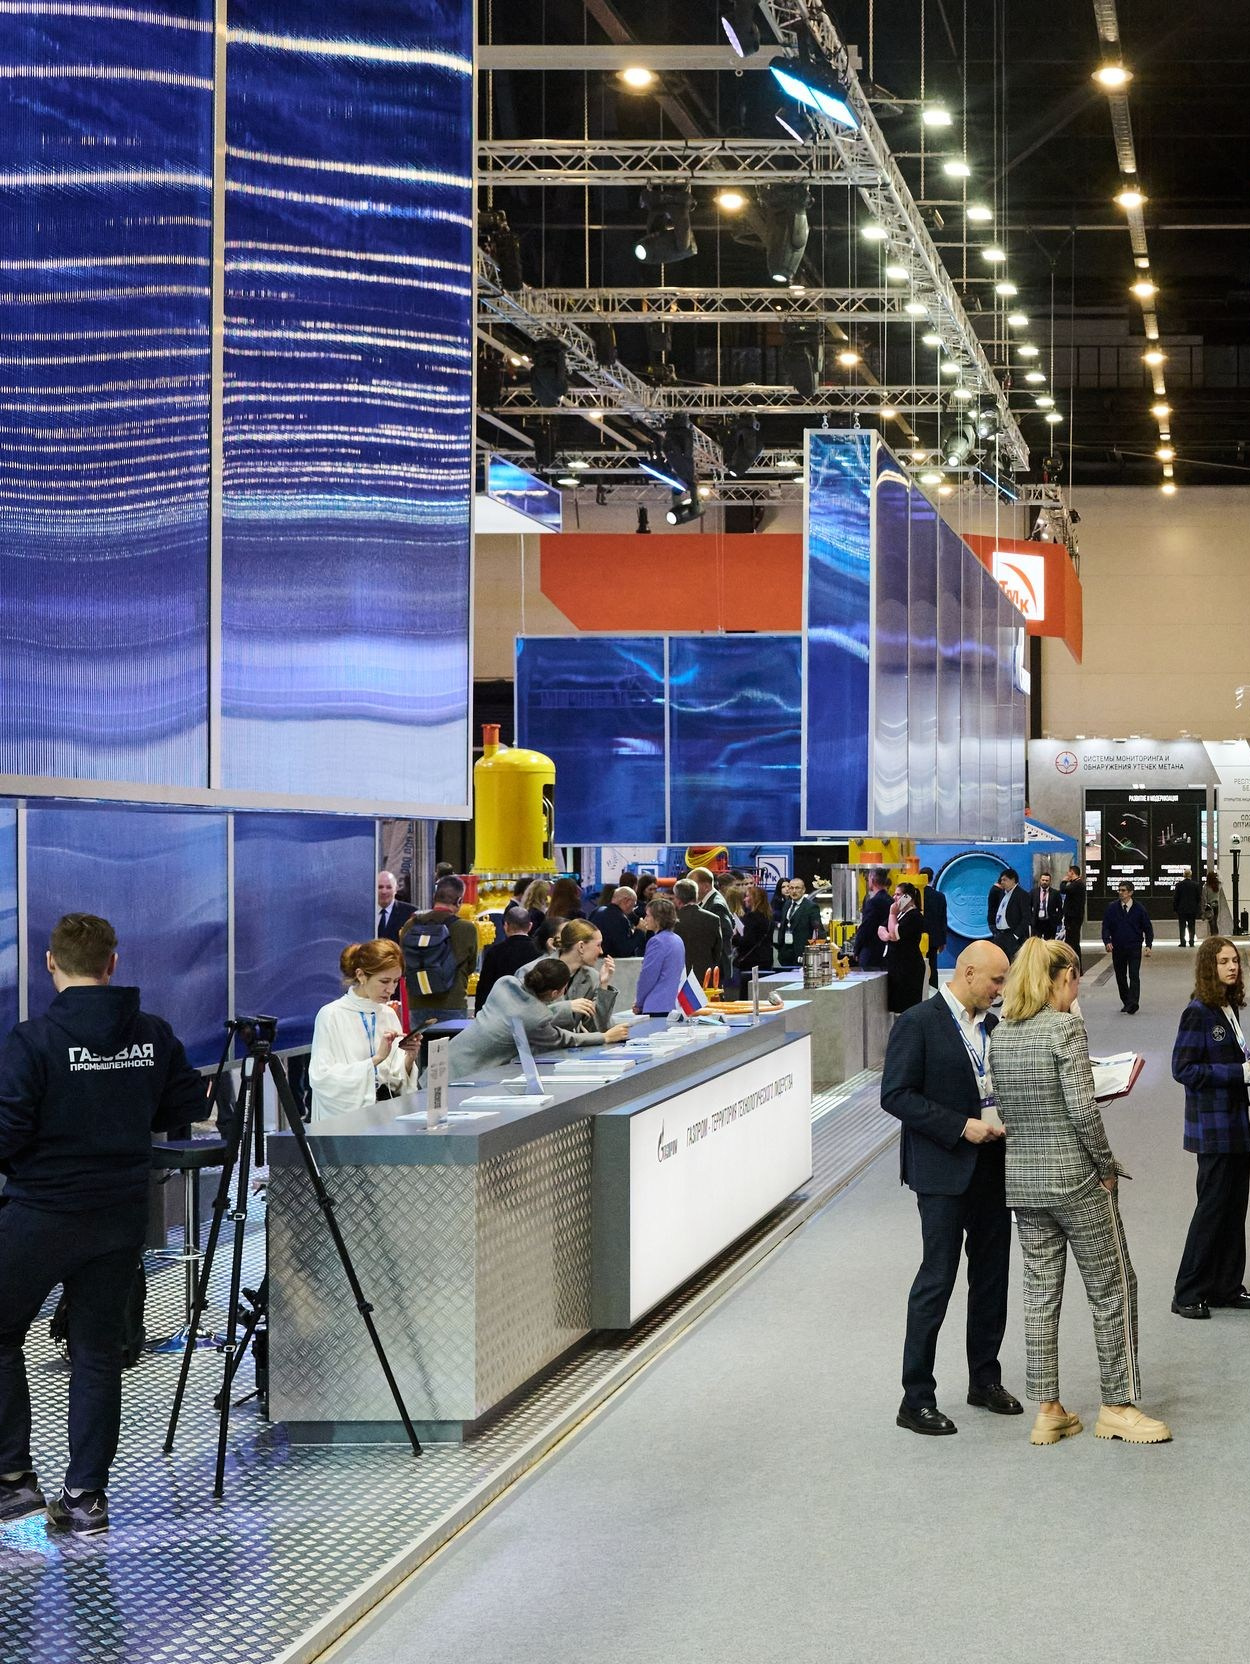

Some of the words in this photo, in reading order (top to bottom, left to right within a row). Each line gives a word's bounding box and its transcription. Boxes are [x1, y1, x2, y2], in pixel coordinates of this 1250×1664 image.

[1083, 763, 1132, 771] ОБНАРУЖЕНИЯ
[1133, 763, 1157, 771] УТЕЧЕК
[1158, 763, 1185, 771] МЕТАНА
[70, 1059, 155, 1072] ПРОМЫШЛЕННОСТЬ
